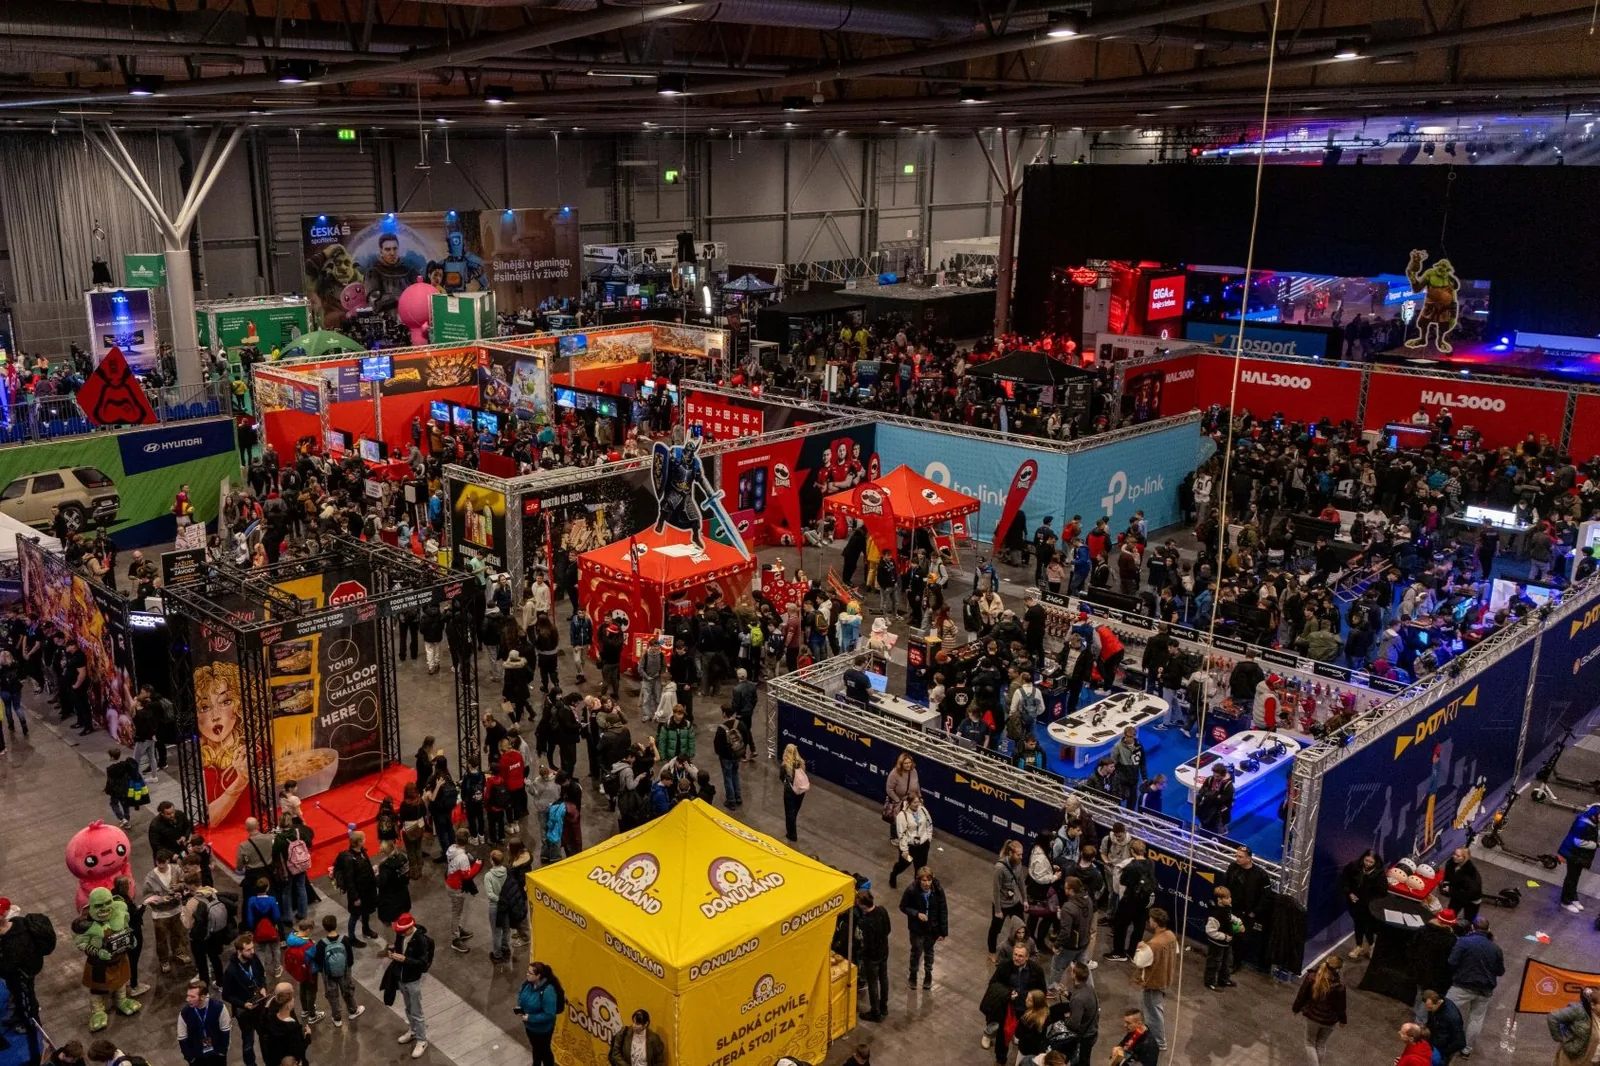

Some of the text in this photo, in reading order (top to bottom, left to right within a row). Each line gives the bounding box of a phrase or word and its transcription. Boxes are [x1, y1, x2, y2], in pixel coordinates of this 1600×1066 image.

[311, 224, 340, 237] ČESKÁ
[493, 260, 525, 271] Silnější
[534, 258, 573, 270] gamingu,
[493, 271, 531, 282] #silnější
[536, 271, 542, 279] v
[543, 268, 569, 279] životě
[1165, 369, 1195, 383] HAL3000
[1241, 370, 1312, 390] HAL3000
[1420, 390, 1506, 413] HAL3000
[162, 437, 203, 449] HYUNDAI
[1128, 474, 1164, 504] tp-link
[390, 598, 405, 606] FOOD
[405, 594, 418, 603] THAT
[297, 613, 344, 629] FOOD THAT KEEPS
[317, 623, 328, 631] THE
[329, 619, 344, 628] LOOP
[328, 657, 354, 672] YOUR
[345, 664, 377, 685] LOOP
[331, 676, 377, 700] CHALLENGE
[320, 704, 357, 728] HERE
[1414, 695, 1464, 746] DATART
[826, 722, 860, 741] DATART
[970, 779, 1010, 802] DATART
[588, 866, 662, 915] DONULAND
[700, 872, 785, 919] DONULAND
[535, 887, 587, 929] DONULAND
[781, 894, 843, 936] DONULAND
[605, 931, 664, 979] DONULAND
[690, 938, 760, 981] DONULAND
[741, 983, 786, 1015] DONULAND
[716, 993, 809, 1050] SLADKÁ CHVÍLE,
[749, 1023, 778, 1052] STOJÍ
[779, 1018, 796, 1035] ZA
